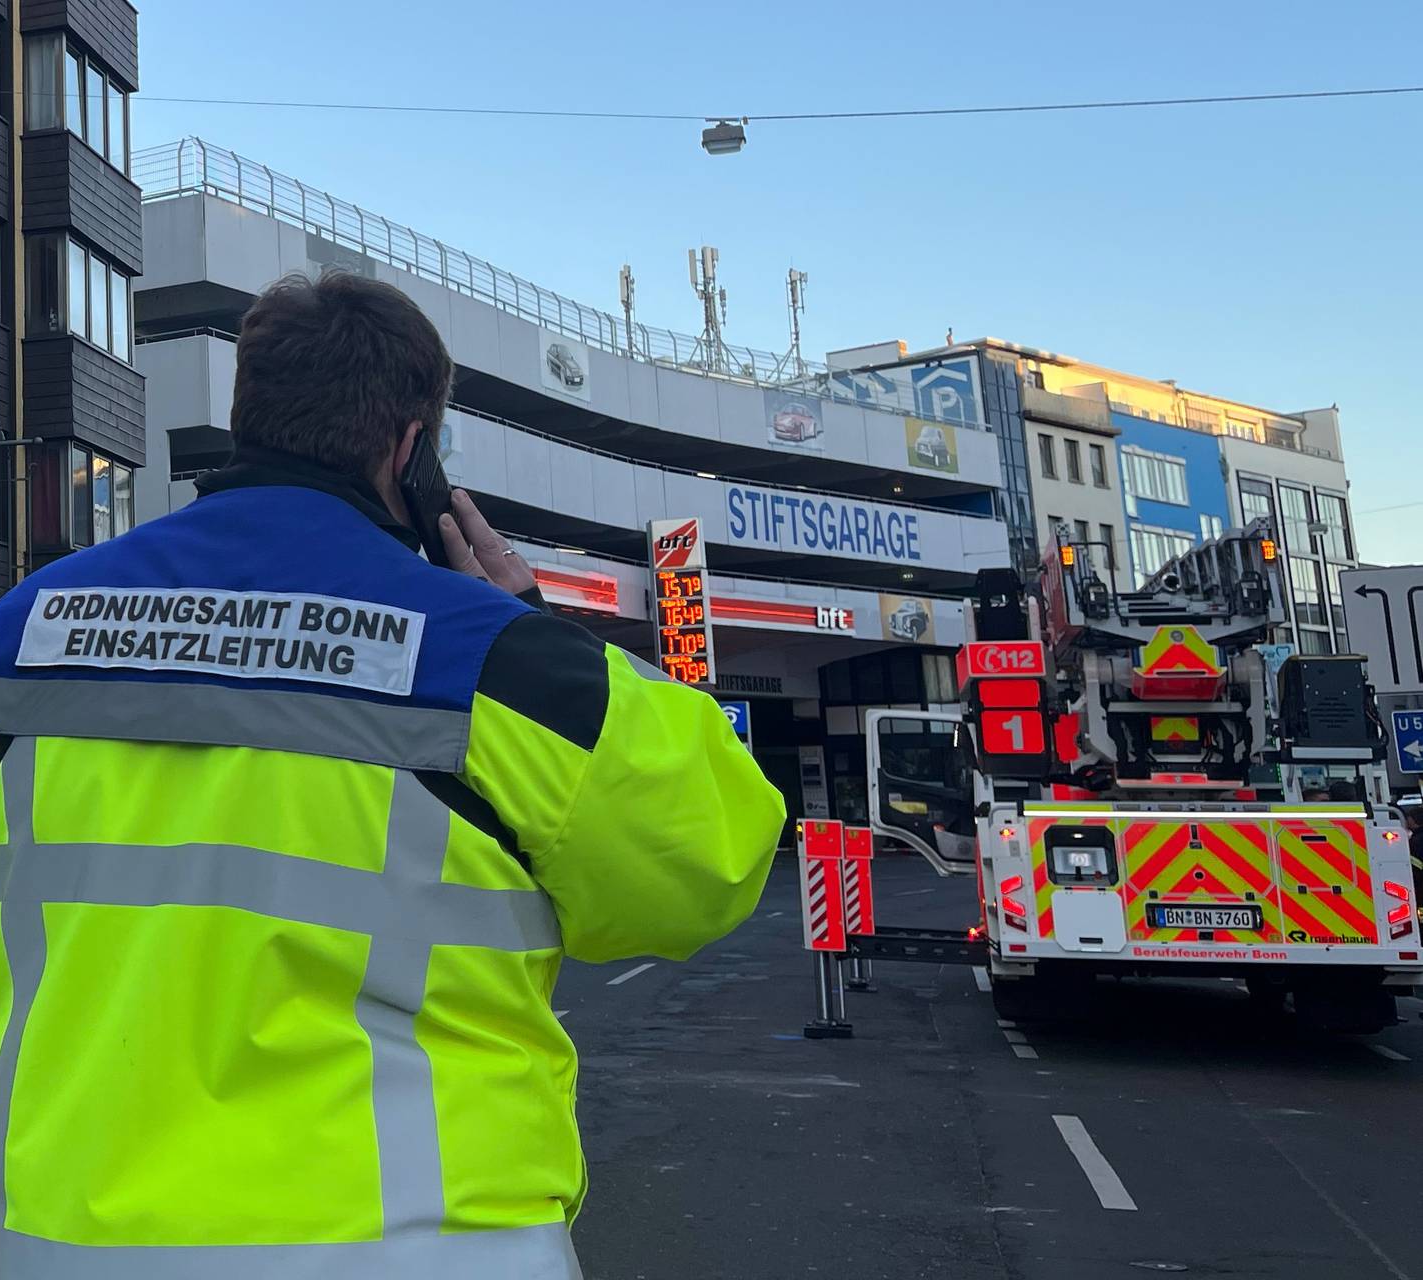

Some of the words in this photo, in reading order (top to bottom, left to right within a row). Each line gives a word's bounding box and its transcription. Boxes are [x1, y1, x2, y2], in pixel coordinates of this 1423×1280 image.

[728, 487, 921, 561] STIFTSGARAGE
[658, 534, 693, 551] bft
[42, 594, 290, 630] ORDNUNGSAMT
[298, 601, 409, 645] BONN
[816, 606, 848, 630] bft
[64, 628, 356, 675] EINSATZLEITUNG
[998, 650, 1035, 669] 112
[715, 674, 783, 694] STIFTSGARAGE
[1002, 715, 1024, 750] 1
[1398, 718, 1409, 731] U
[1166, 910, 1185, 924] BN
[1194, 911, 1212, 925] BN
[1217, 911, 1250, 926] 3760
[1132, 946, 1249, 960] Berufsfeuerwehr
[1252, 948, 1288, 960] Bonn
